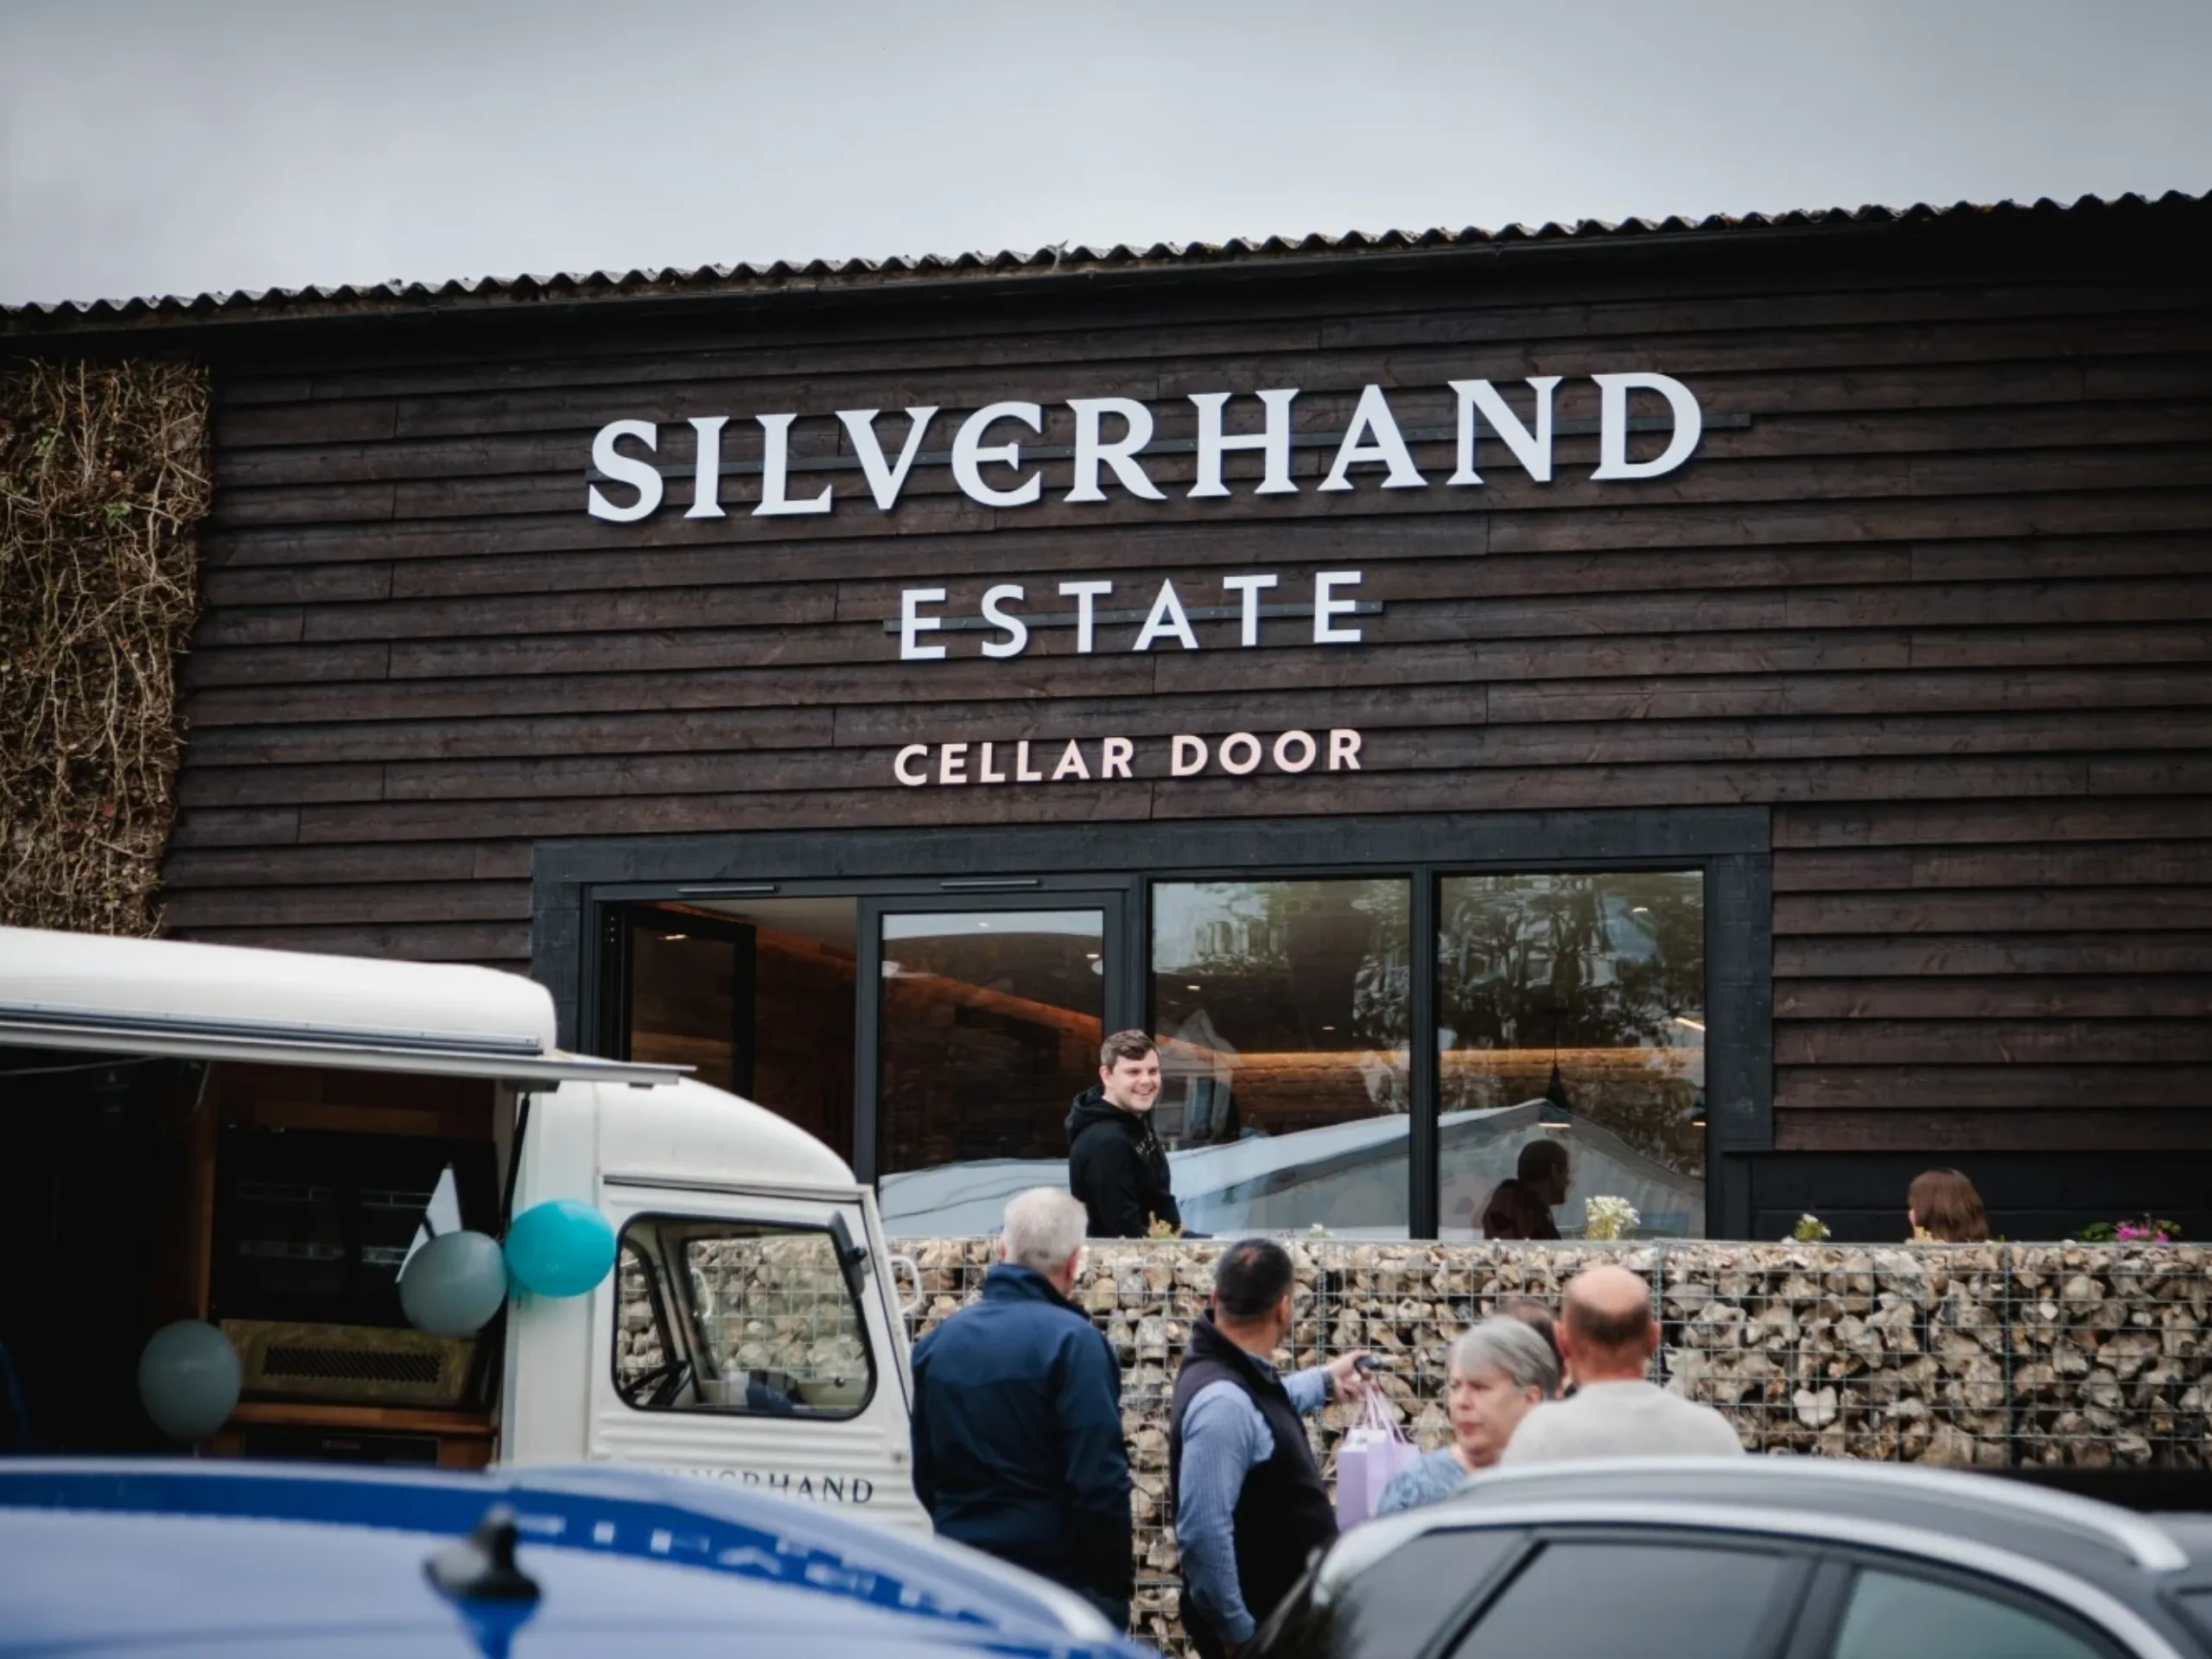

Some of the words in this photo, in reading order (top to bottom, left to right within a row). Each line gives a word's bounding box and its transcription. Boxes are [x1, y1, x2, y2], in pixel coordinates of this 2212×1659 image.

[587, 372, 1703, 523] SILVERHAND
[899, 570, 1363, 660] ESTATE
[893, 737, 1135, 787] CELLAR
[1171, 728, 1363, 777] DOOR
